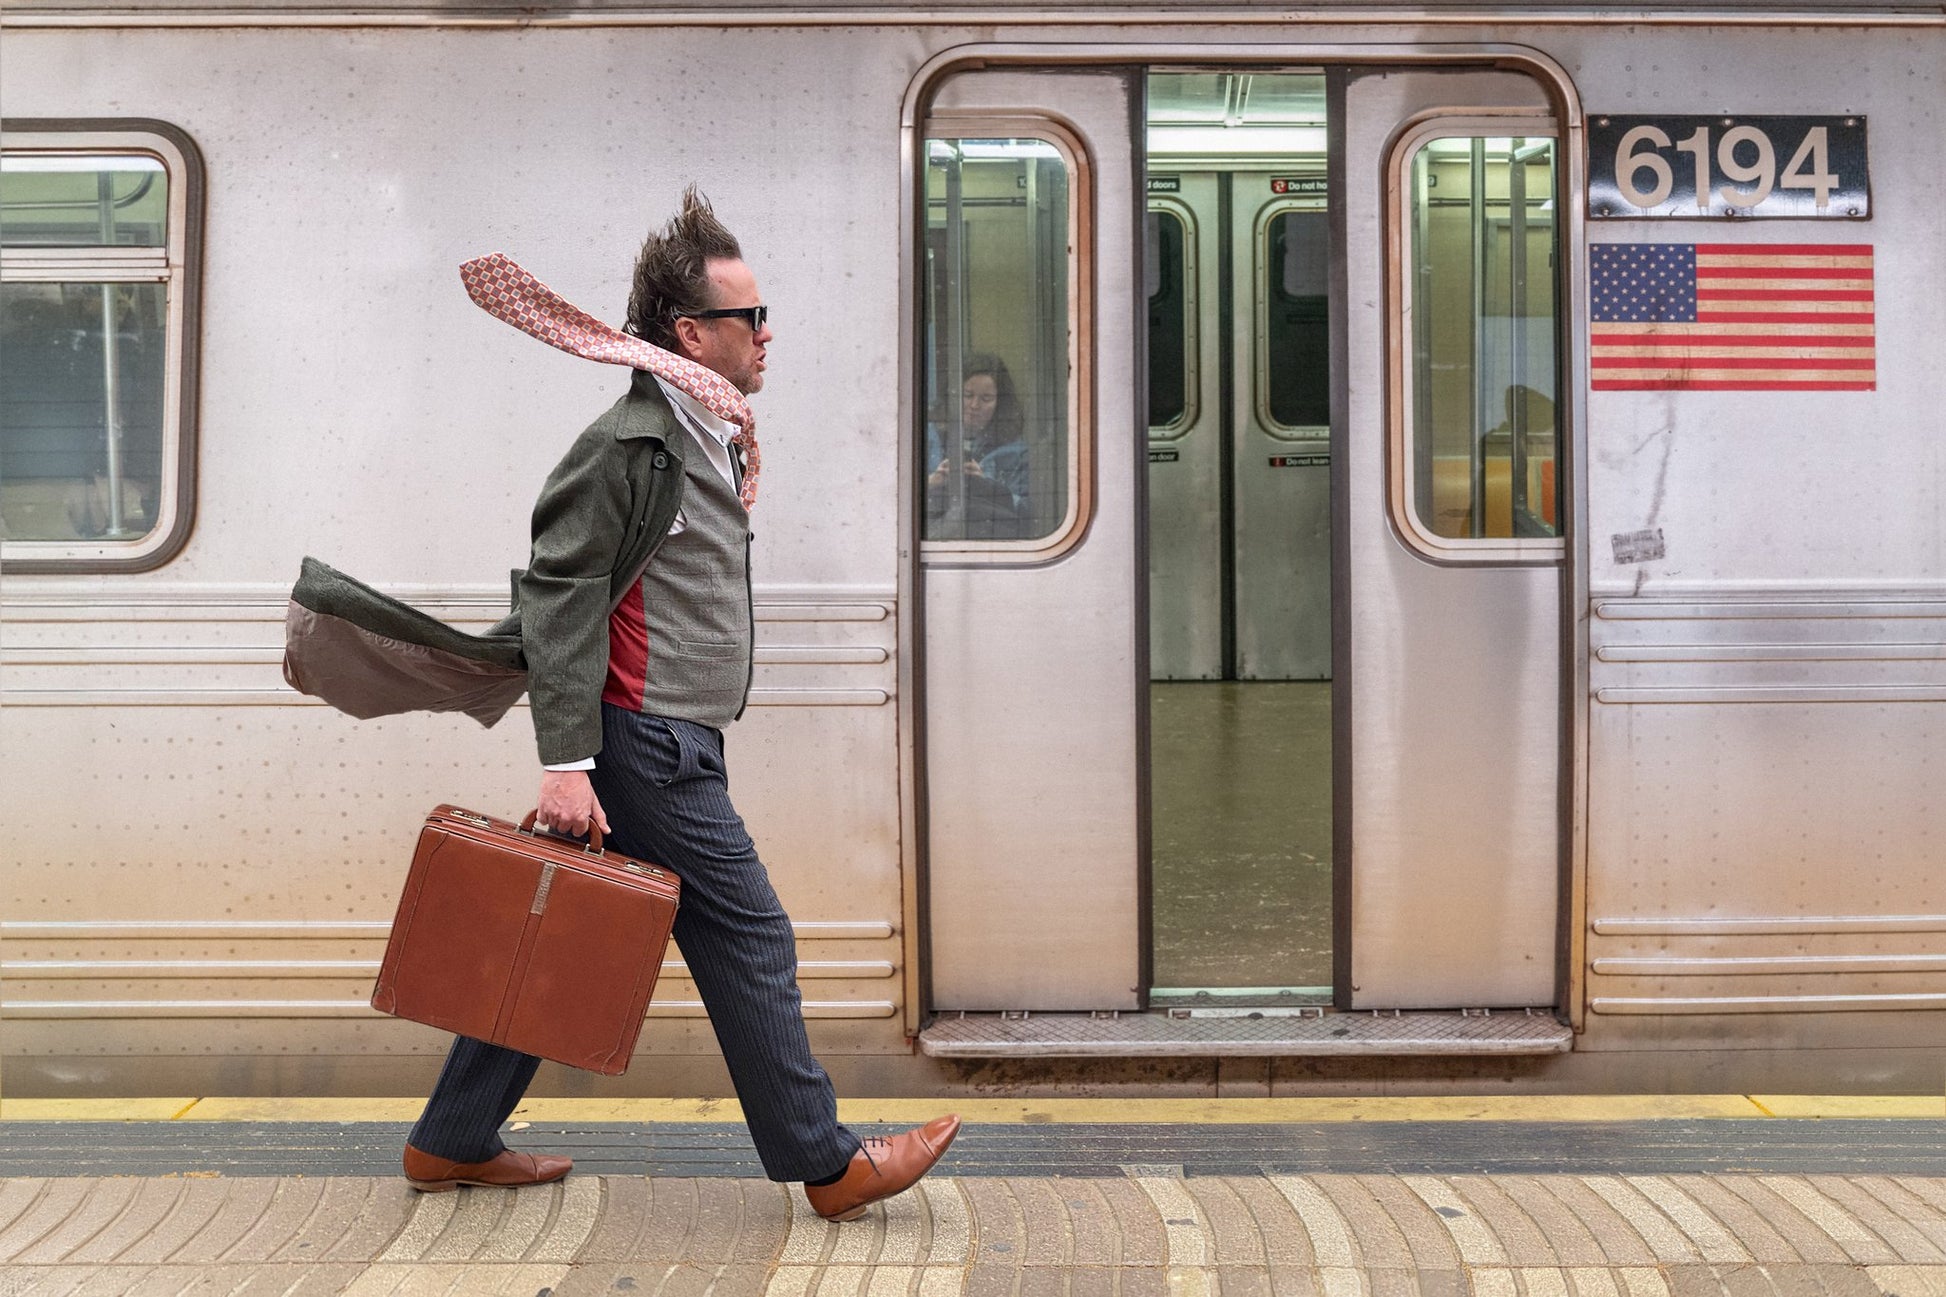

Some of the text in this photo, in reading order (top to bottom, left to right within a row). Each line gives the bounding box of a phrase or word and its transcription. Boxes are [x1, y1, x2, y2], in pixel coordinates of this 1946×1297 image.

[1615, 125, 1839, 208] 6194
[1152, 181, 1177, 189] doors
[1288, 181, 1300, 190] Do
[1301, 181, 1315, 190] not
[1158, 453, 1176, 461] door
[1286, 457, 1329, 466] Do not lean
